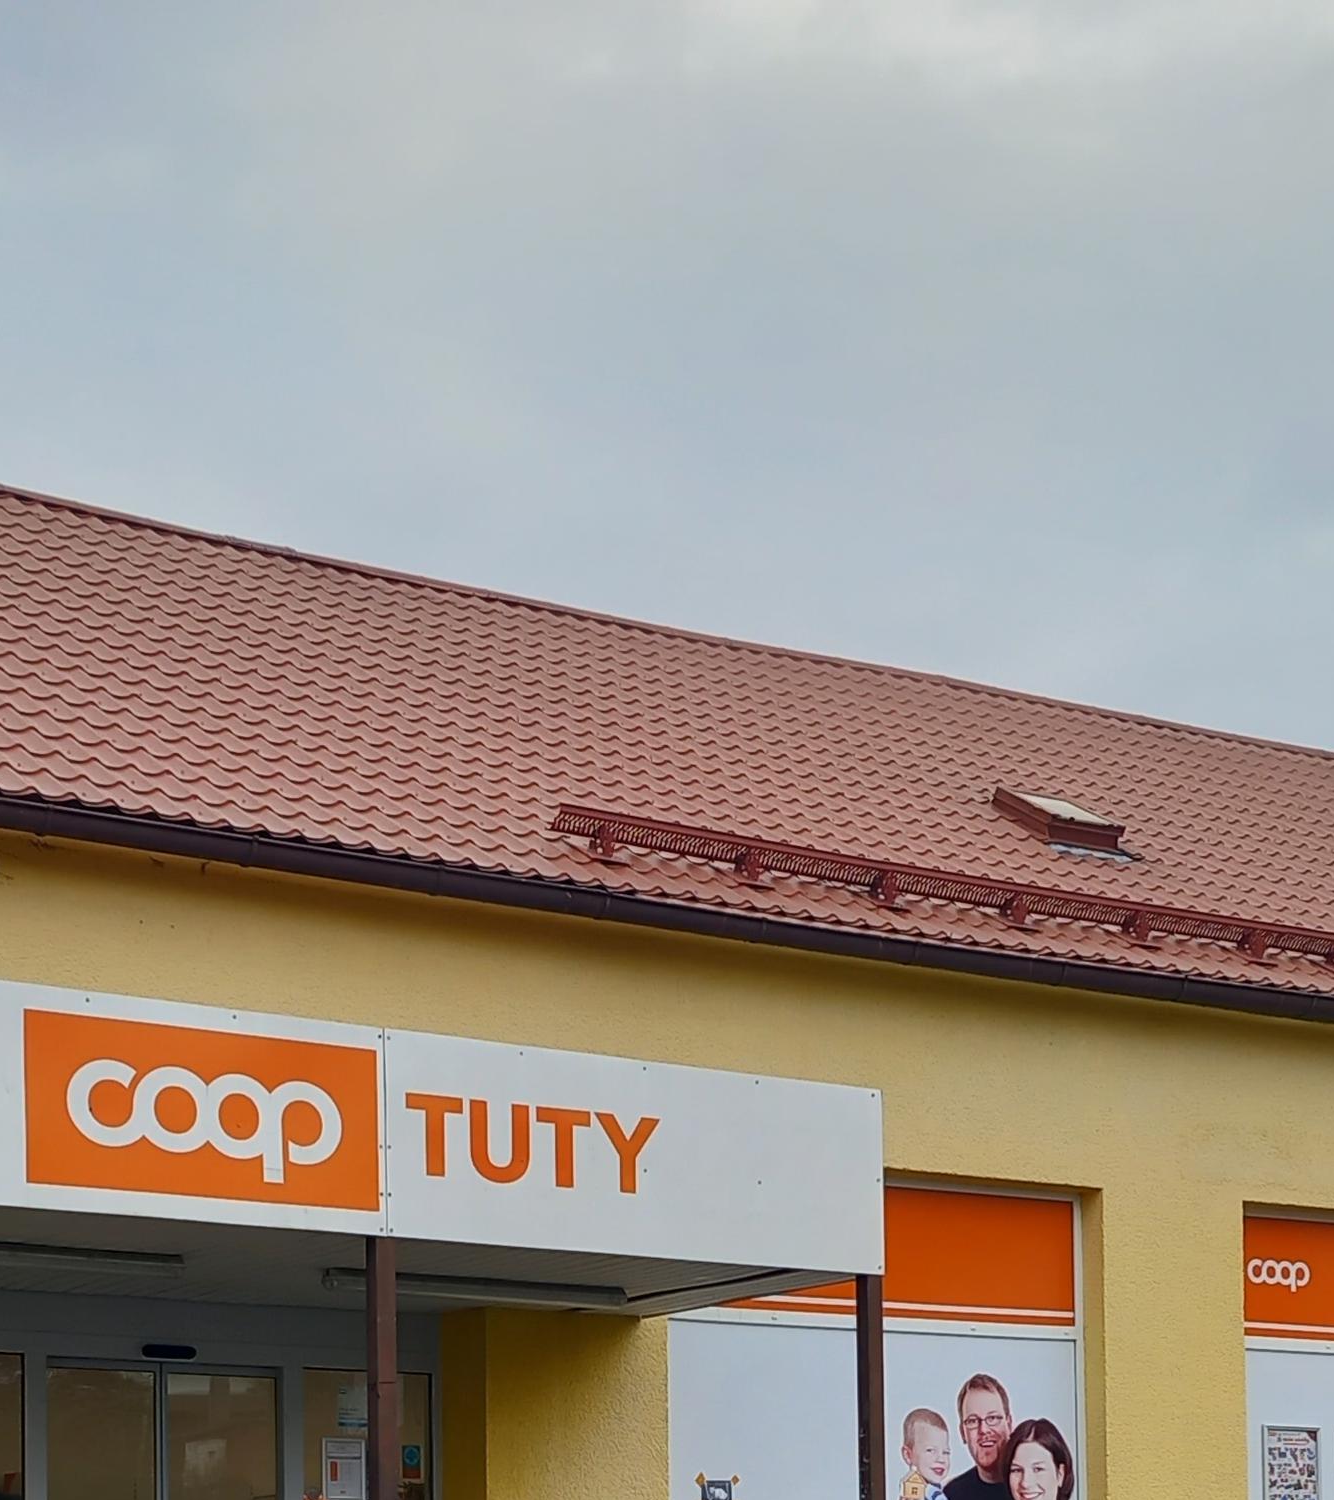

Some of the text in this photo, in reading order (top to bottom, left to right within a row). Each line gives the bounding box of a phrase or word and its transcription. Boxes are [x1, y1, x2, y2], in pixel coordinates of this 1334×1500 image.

[67, 1058, 660, 1194] coop TUTY
[1247, 1258, 1310, 1293] coop
